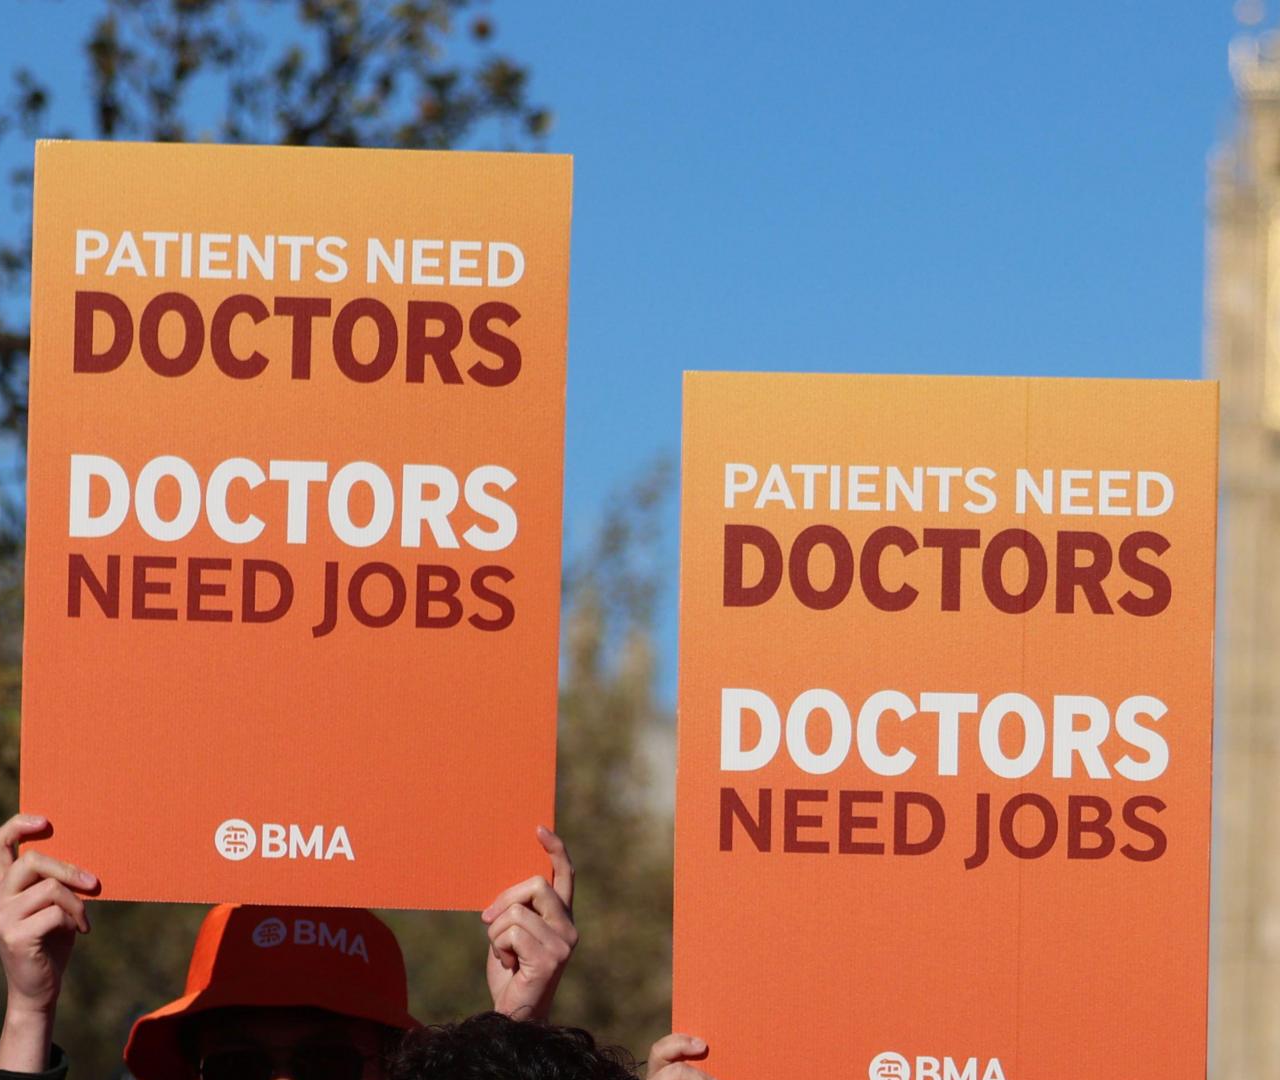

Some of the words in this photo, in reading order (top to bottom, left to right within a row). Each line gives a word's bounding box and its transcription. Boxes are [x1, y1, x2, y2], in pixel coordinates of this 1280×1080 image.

[75, 230, 348, 282] PATIENTS
[367, 239, 524, 288] NEED
[74, 291, 521, 387] DOCTORS
[69, 454, 518, 551] DOCTORS
[724, 463, 996, 514] PATIENTS
[1015, 469, 1174, 516] NEED
[67, 554, 294, 624] NEED
[312, 561, 515, 638] JOBS
[723, 524, 1172, 617] DOCTORS
[720, 688, 1169, 781] DOCTORS
[262, 824, 355, 861] BMA
[719, 788, 946, 856] NEED
[964, 793, 1167, 871] JOBS
[294, 919, 369, 963] BMA
